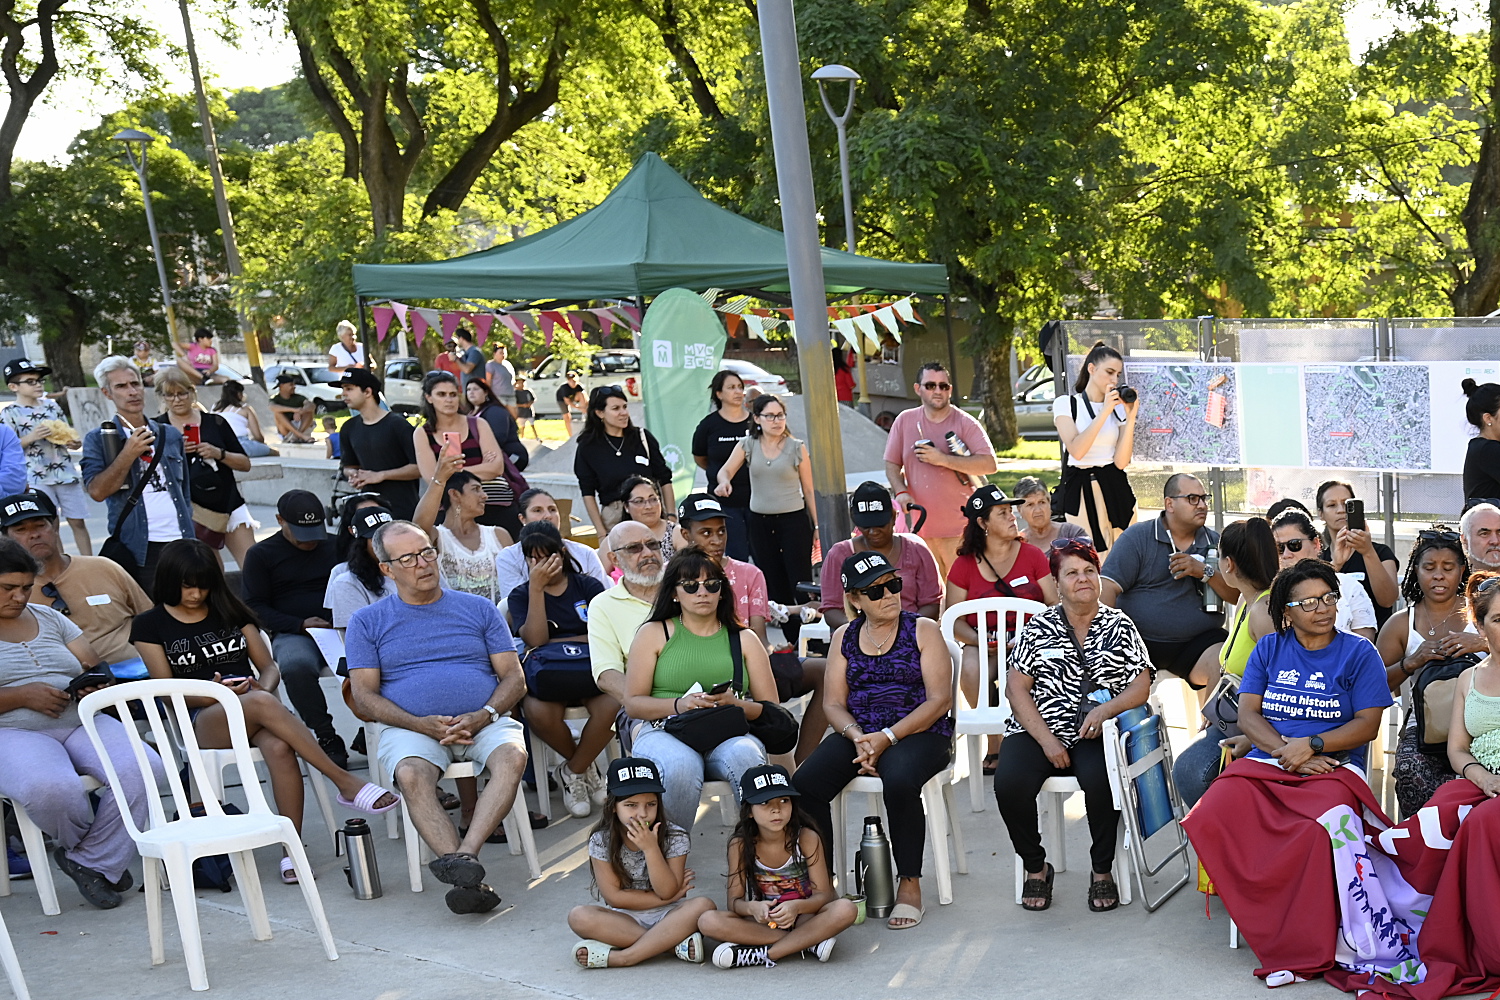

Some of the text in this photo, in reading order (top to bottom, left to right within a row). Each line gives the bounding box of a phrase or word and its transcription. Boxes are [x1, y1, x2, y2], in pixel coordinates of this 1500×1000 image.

[166, 652, 197, 666] LAS
[1263, 690, 1341, 708] Nuestra historia
[1305, 707, 1341, 719] futuro
